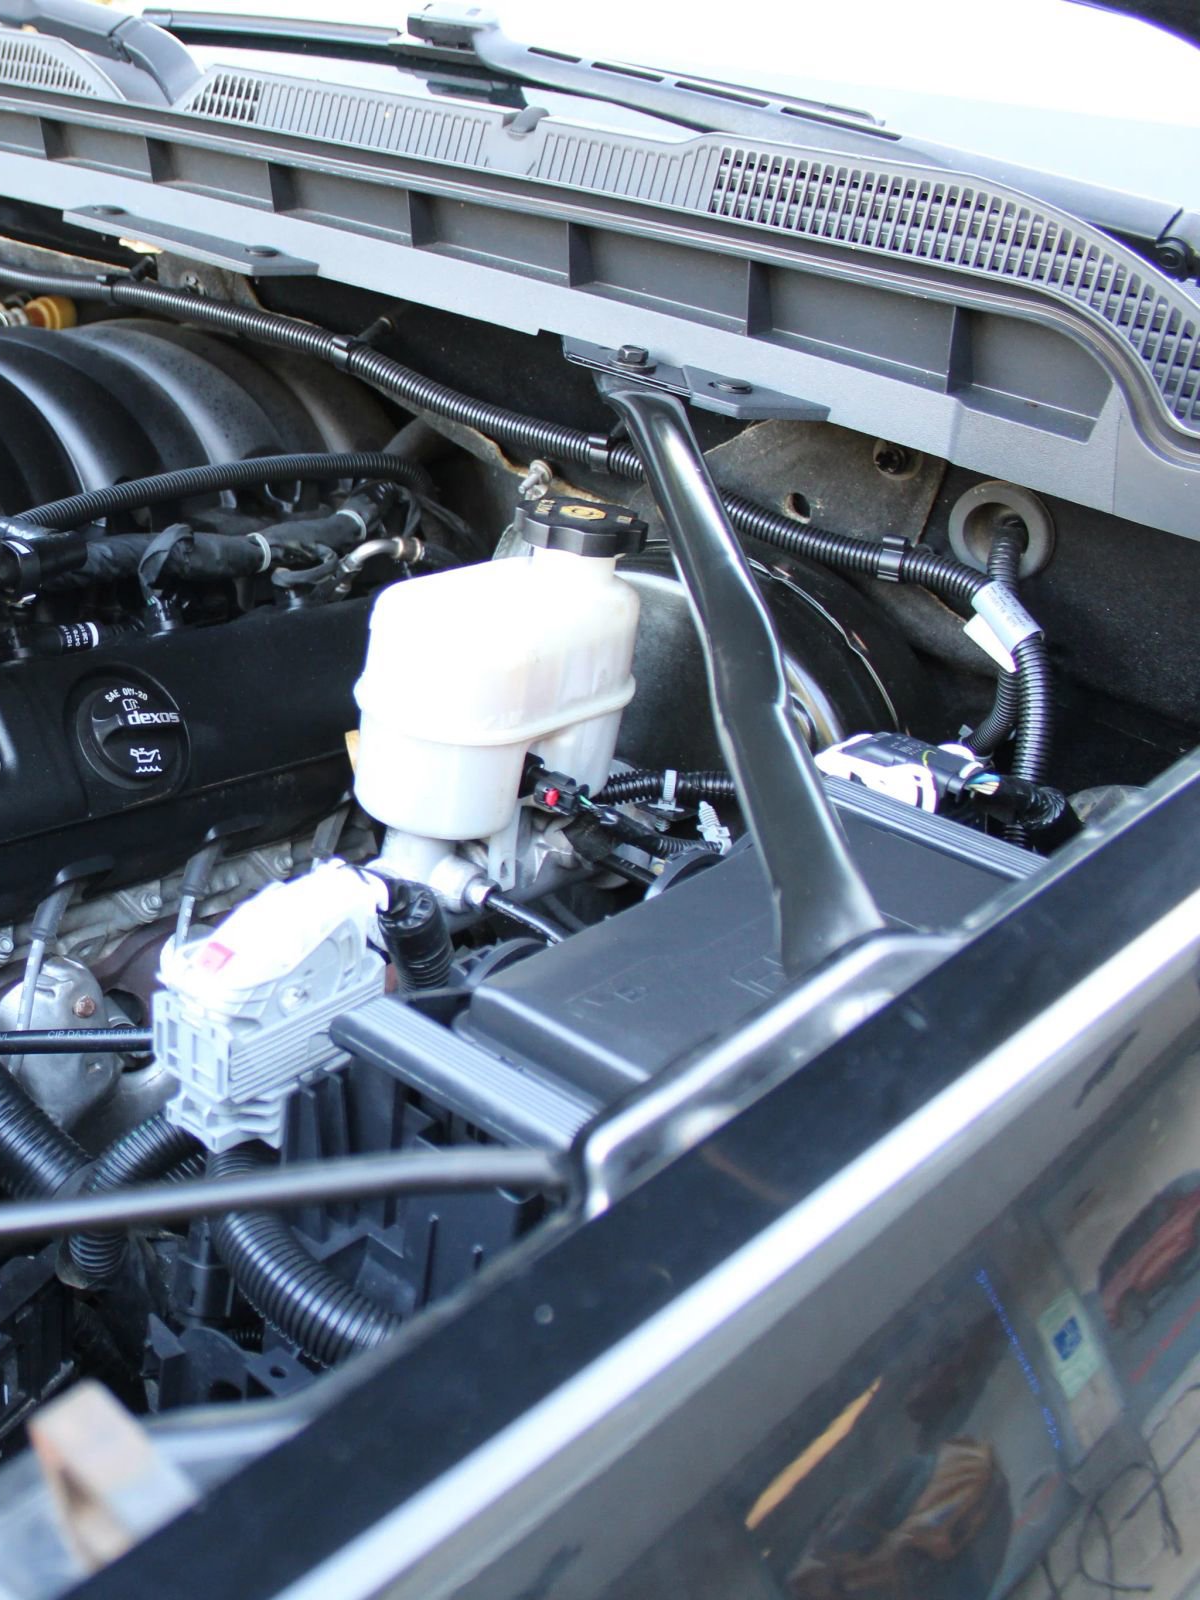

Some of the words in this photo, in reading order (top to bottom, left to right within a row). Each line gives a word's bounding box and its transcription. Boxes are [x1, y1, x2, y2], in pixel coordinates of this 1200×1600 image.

[104, 689, 121, 703] SAE
[127, 710, 180, 725] dexos
[67, 1029, 94, 1040] DATE
